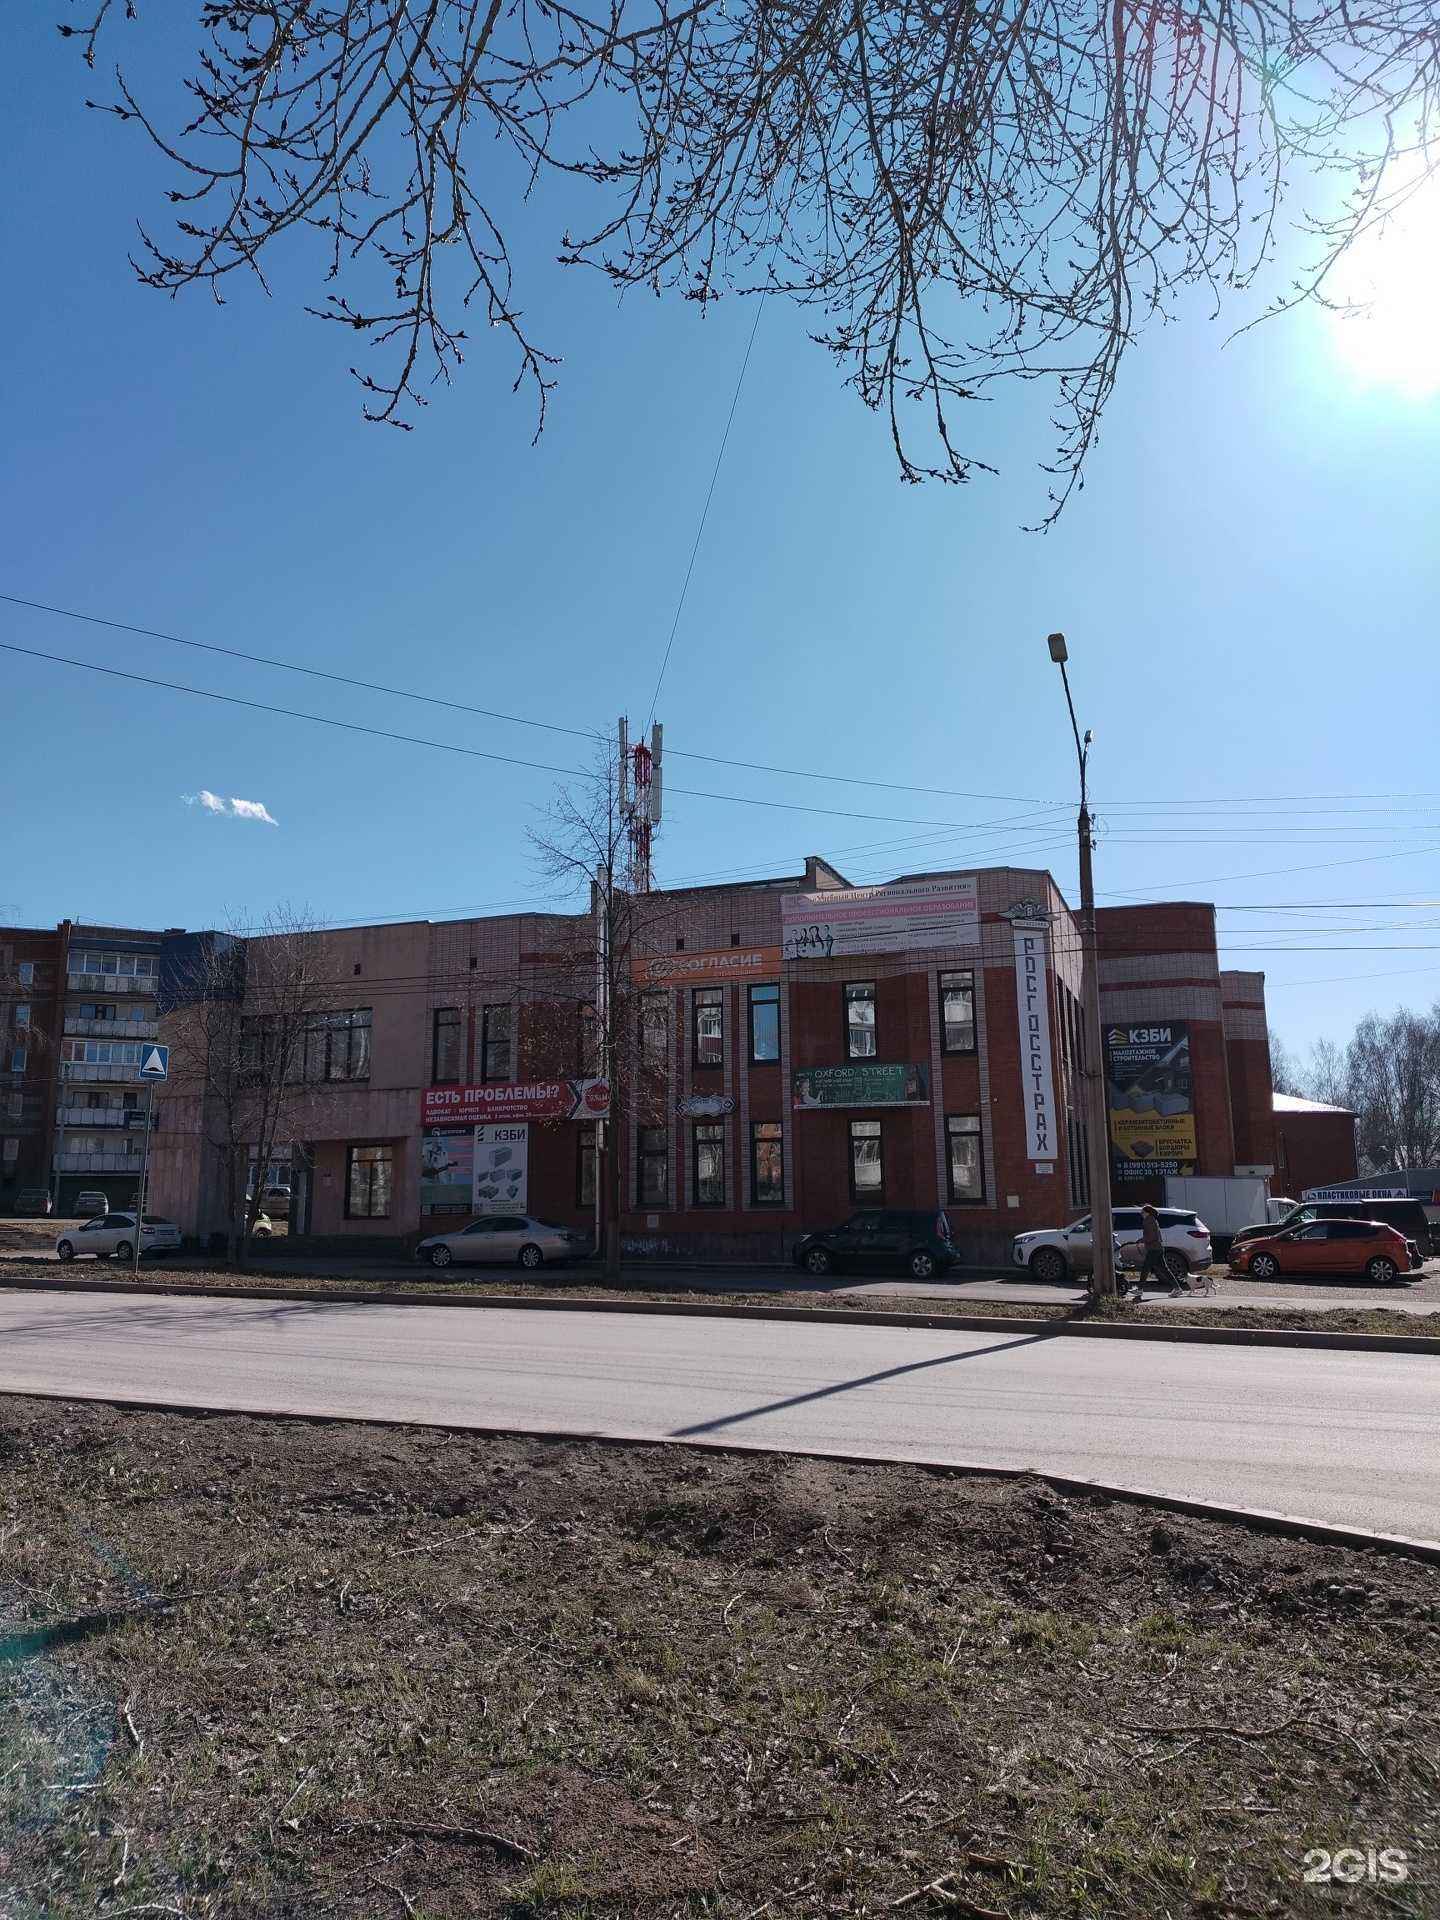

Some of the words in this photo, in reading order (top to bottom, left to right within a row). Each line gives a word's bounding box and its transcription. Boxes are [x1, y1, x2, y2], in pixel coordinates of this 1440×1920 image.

[1129, 1027, 1172, 1043] КЗБИ
[1023, 937, 1048, 1151] РОСГОССТРАХ
[814, 1068, 855, 1078] OXFORD
[862, 1066, 904, 1077] STREET
[426, 1091, 461, 1105] ЕСТЬ
[464, 1085, 560, 1103] ПРОБЛЕМЫ?
[494, 1129, 526, 1141] КЗБИ
[1317, 1189, 1370, 1200] ПЛАСТИКОВЫЕ
[1372, 1189, 1391, 1199] ОКНА
